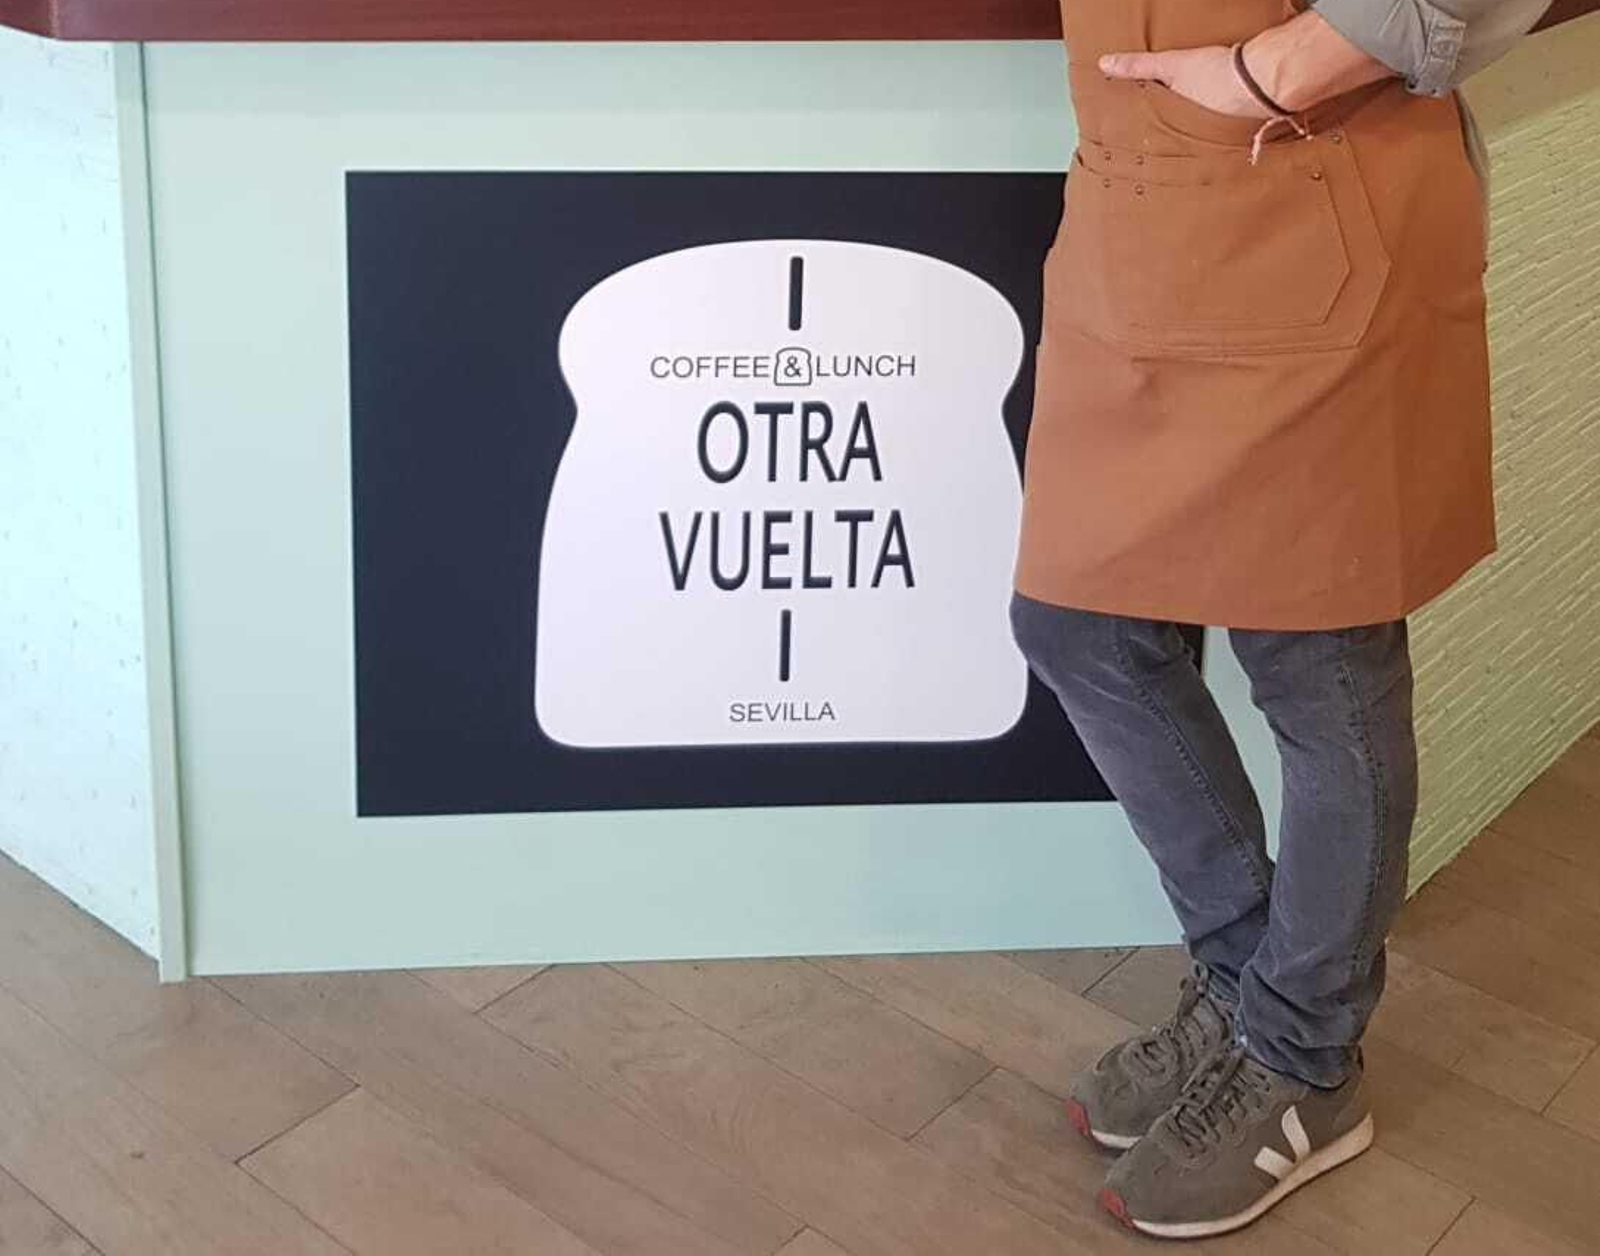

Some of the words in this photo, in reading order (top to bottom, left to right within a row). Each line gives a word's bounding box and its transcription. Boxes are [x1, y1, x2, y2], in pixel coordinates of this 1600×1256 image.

[651, 357, 769, 378] COFFEE
[784, 356, 801, 377] &
[817, 356, 915, 376] LUNCH
[698, 402, 882, 483] OTRA
[660, 510, 914, 591] VUELTA
[730, 702, 835, 722] SEVILLA
